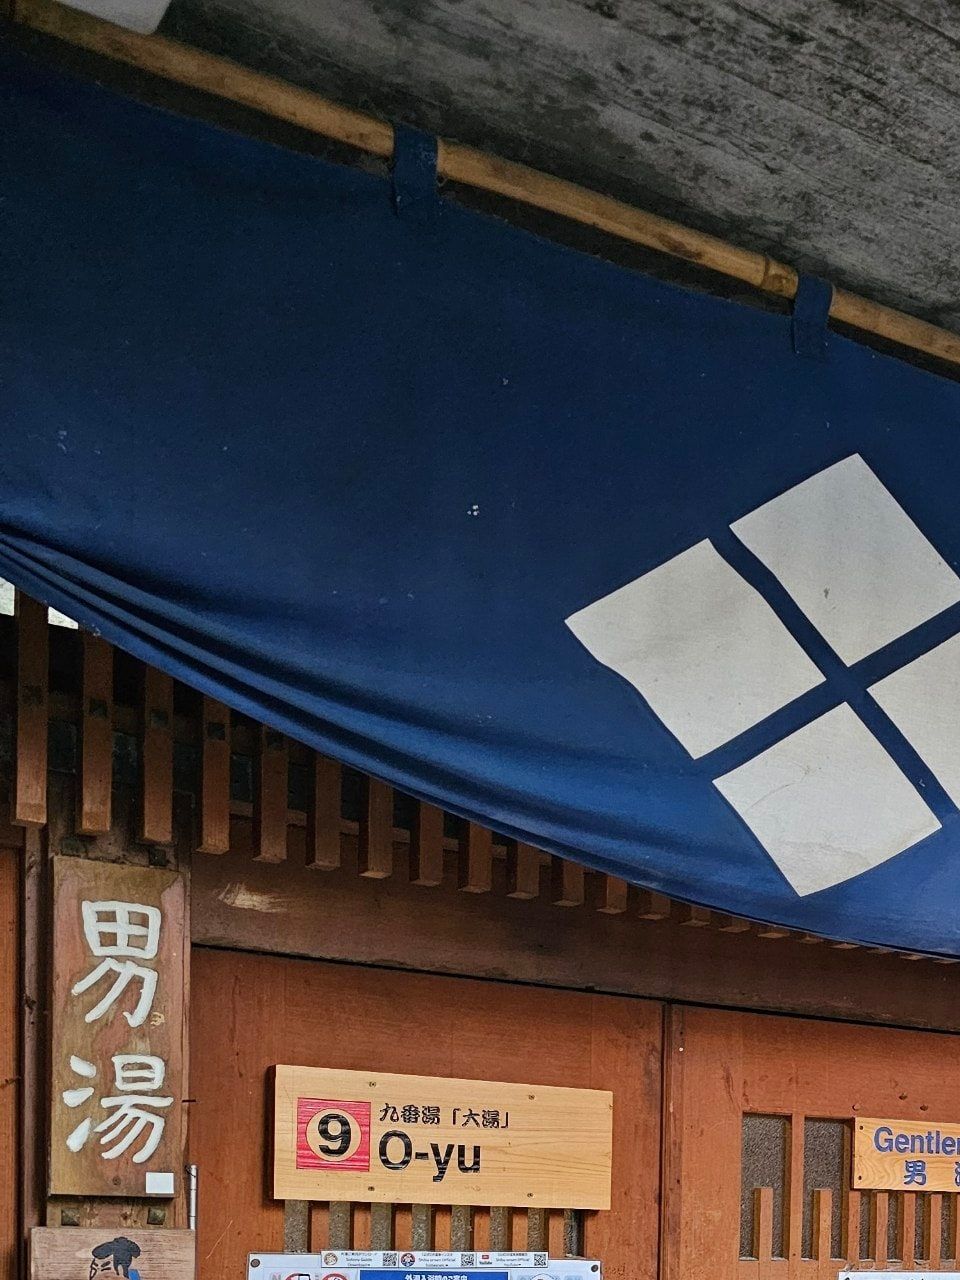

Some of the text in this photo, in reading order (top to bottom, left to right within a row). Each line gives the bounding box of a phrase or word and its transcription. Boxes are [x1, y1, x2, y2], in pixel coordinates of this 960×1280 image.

[63, 900, 174, 1163] 男湯
[318, 1113, 352, 1157] 9
[379, 1130, 481, 1182] O-yu
